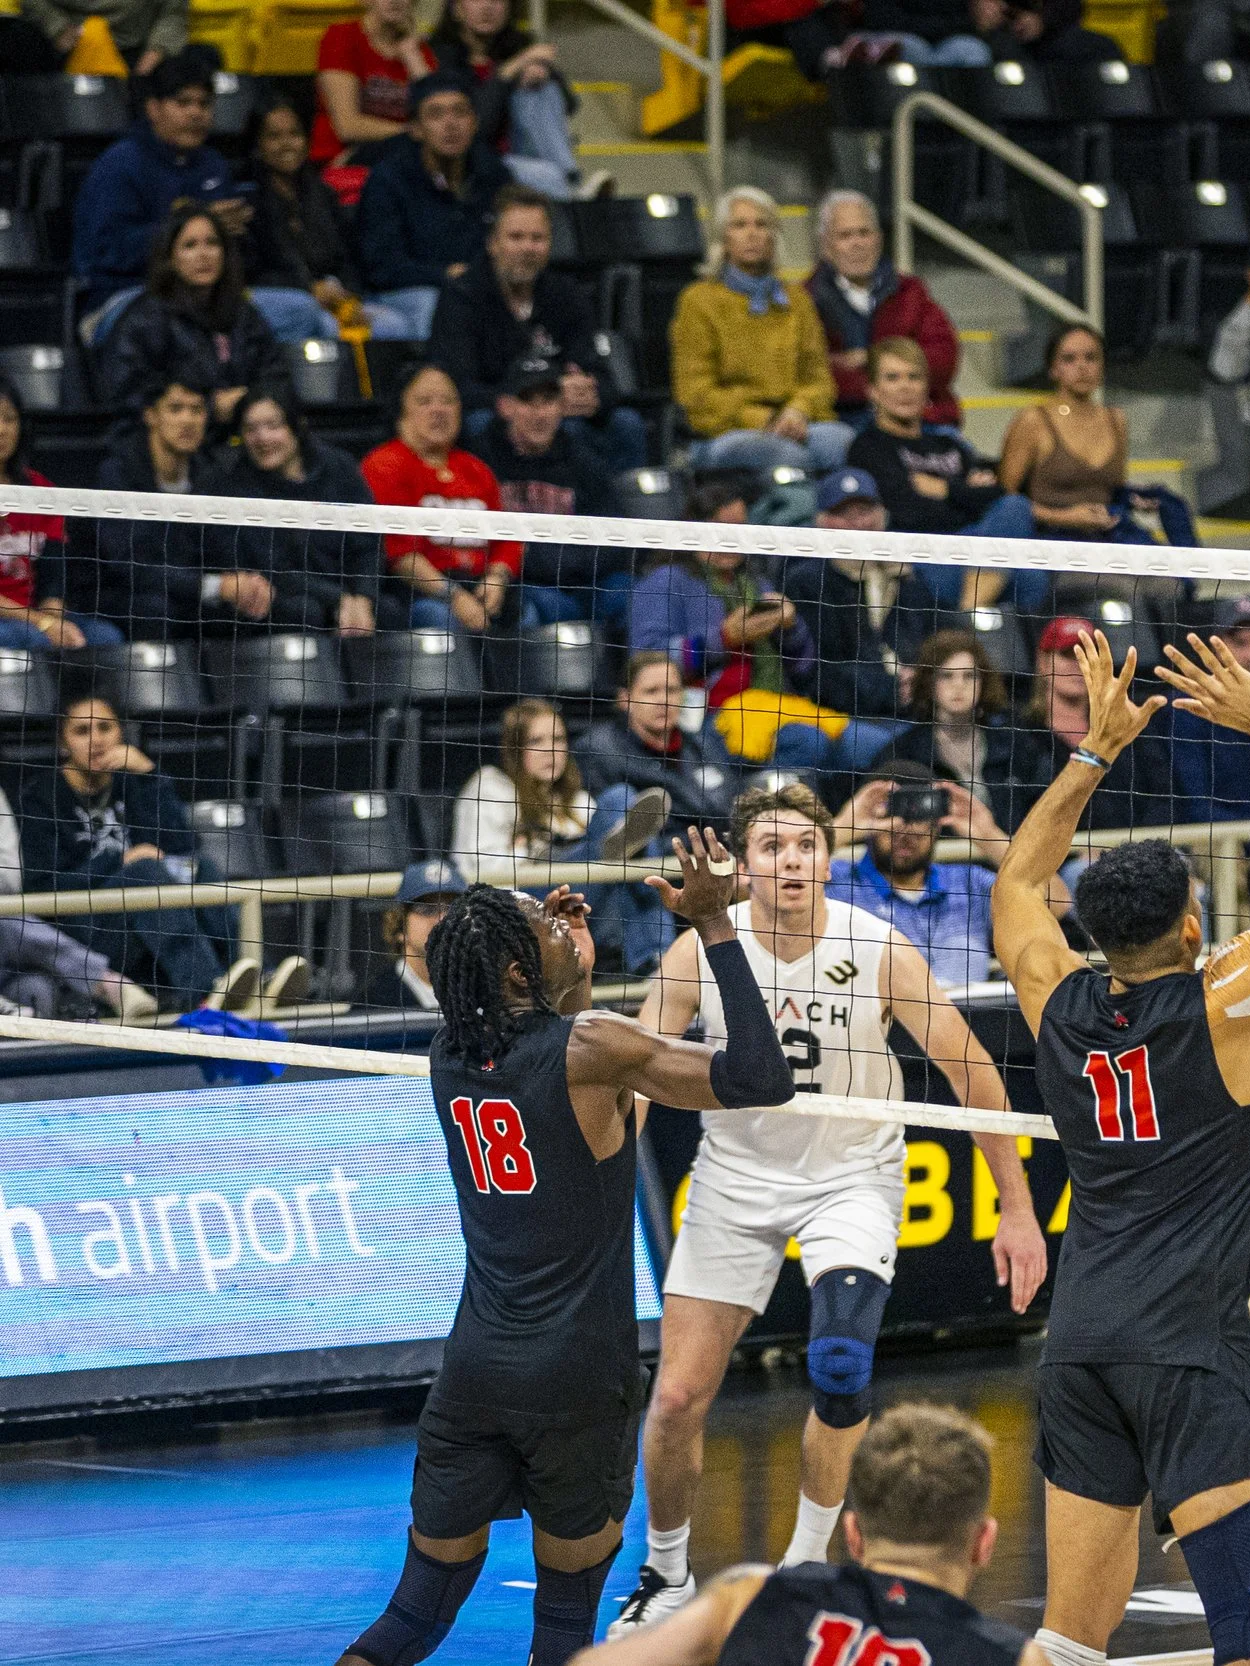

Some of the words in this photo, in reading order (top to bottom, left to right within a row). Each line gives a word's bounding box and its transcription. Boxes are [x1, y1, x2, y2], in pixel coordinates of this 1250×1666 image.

[1082, 1044, 1161, 1141] 11
[450, 1096, 538, 1195] 18
[76, 1167, 376, 1294] airport
